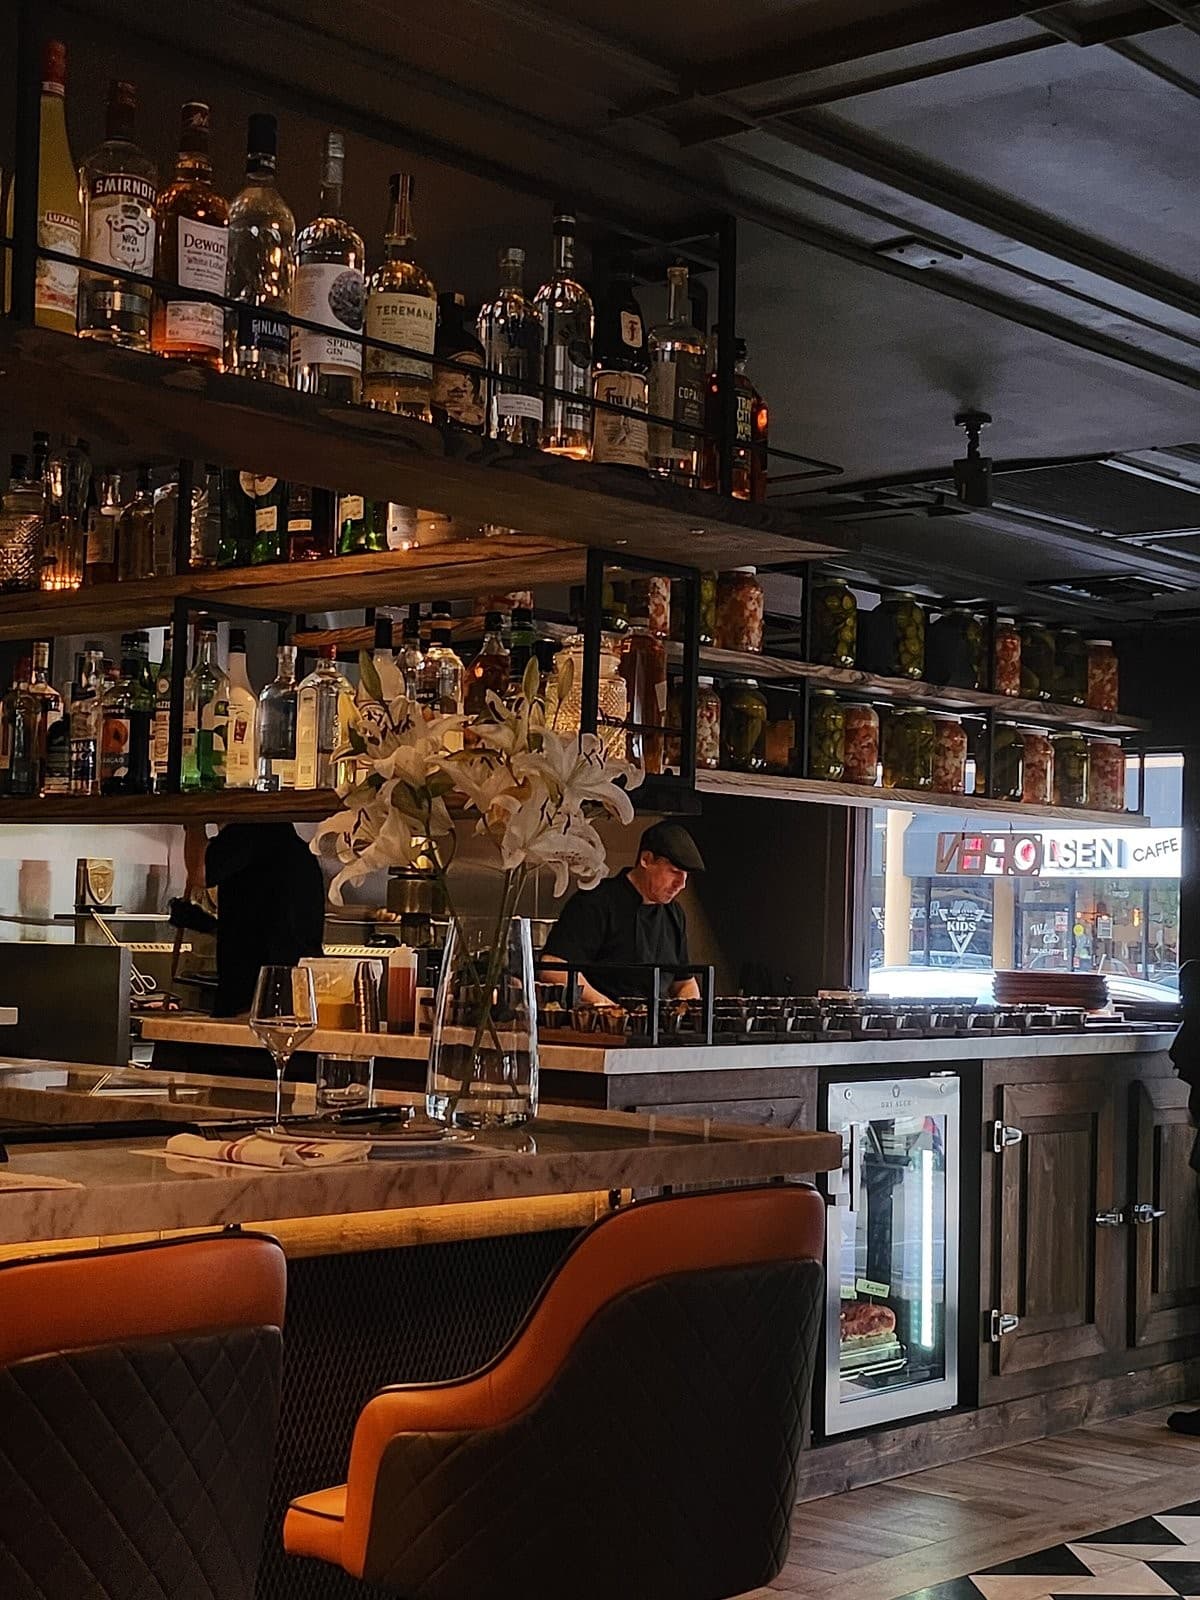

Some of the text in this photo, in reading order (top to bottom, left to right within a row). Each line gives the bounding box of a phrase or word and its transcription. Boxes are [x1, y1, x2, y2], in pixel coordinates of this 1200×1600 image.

[376, 304, 434, 321] TEREMANA
[326, 347, 343, 356] GIN
[1132, 837, 1179, 862] CAFFE
[946, 920, 977, 932] KIDS
